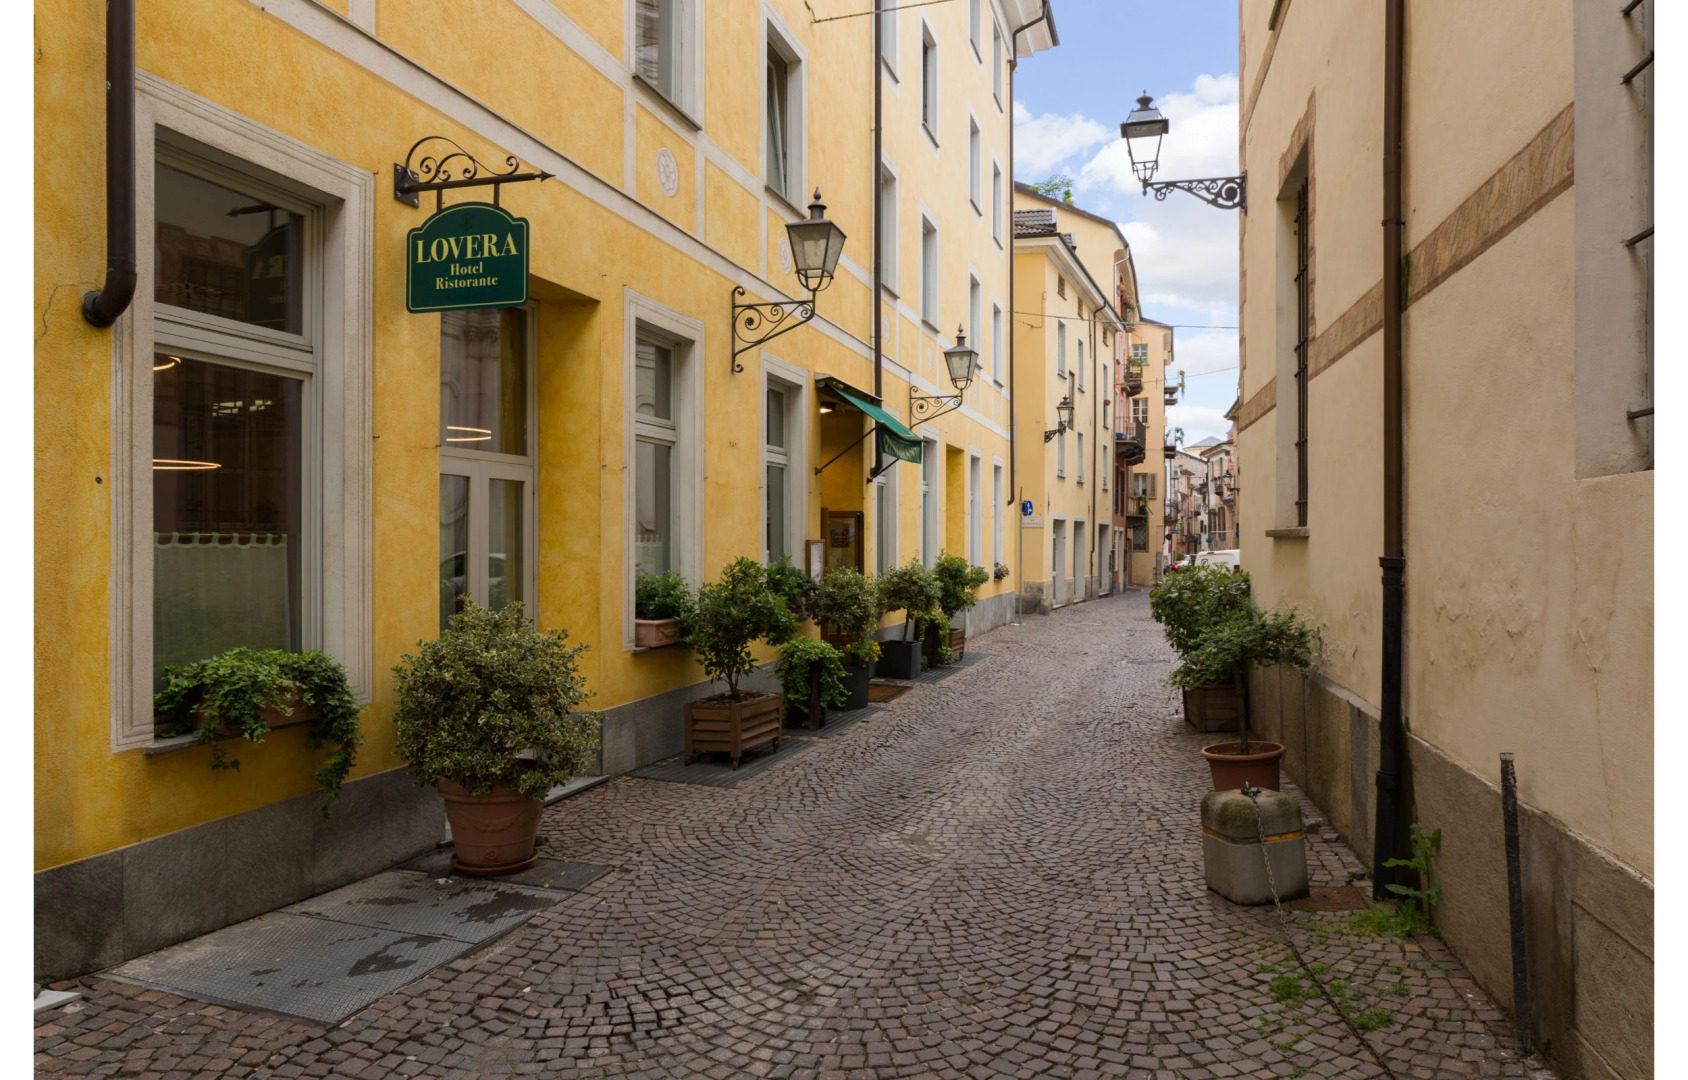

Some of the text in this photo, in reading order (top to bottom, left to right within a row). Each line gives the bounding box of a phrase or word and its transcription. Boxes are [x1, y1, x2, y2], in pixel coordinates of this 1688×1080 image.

[416, 232, 519, 263] LOVERA
[450, 261, 483, 275] Hotel
[435, 276, 498, 289] Ristorante
